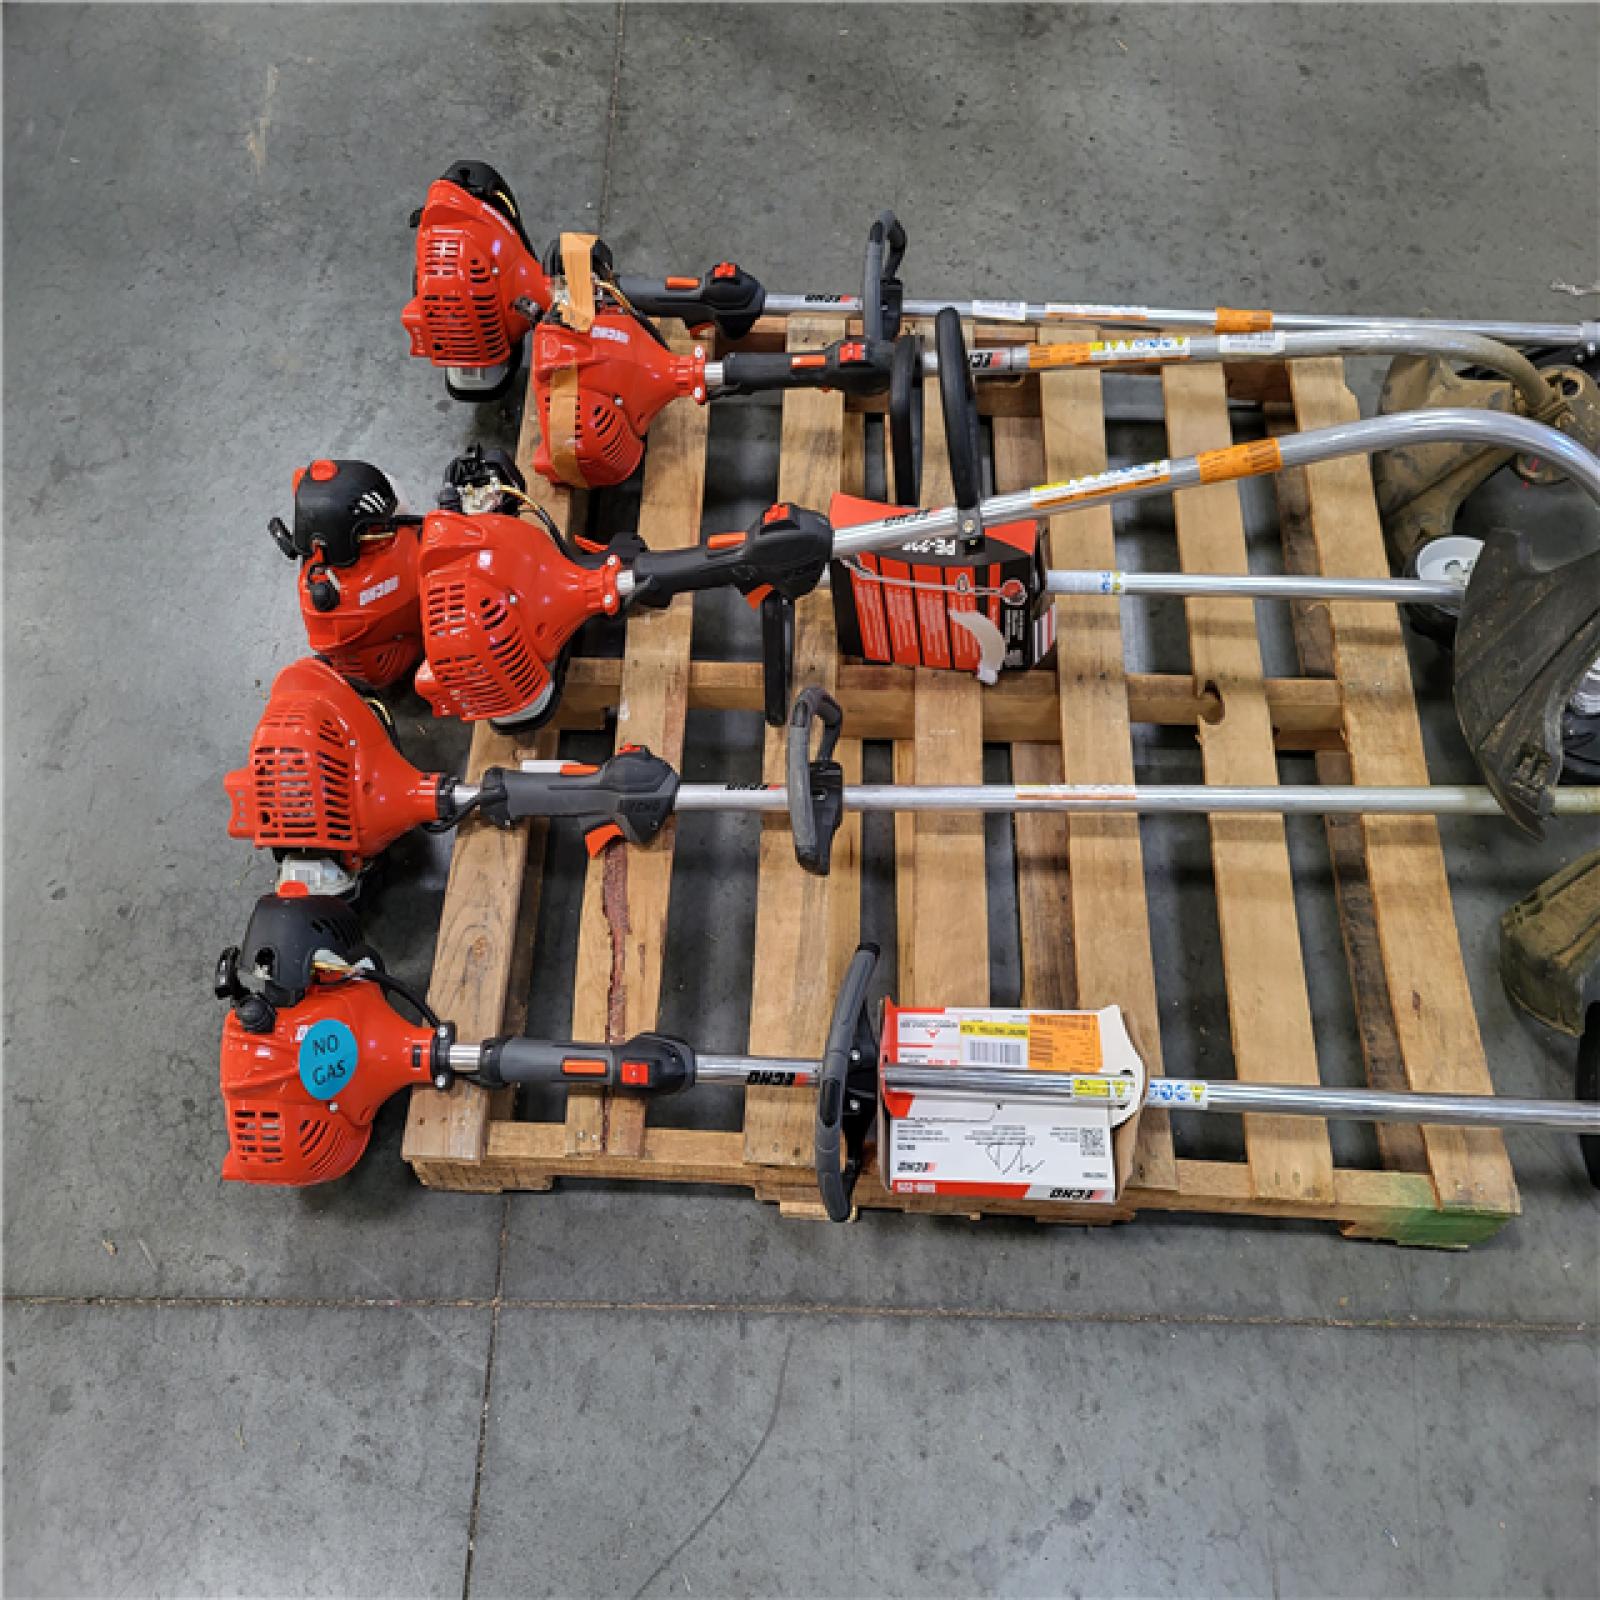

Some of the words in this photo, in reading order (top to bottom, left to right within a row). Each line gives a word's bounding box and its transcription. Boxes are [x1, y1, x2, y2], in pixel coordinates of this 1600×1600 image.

[312, 1034, 340, 1056] NO
[312, 1059, 346, 1086] GAS
[747, 1069, 796, 1086] ECHO
